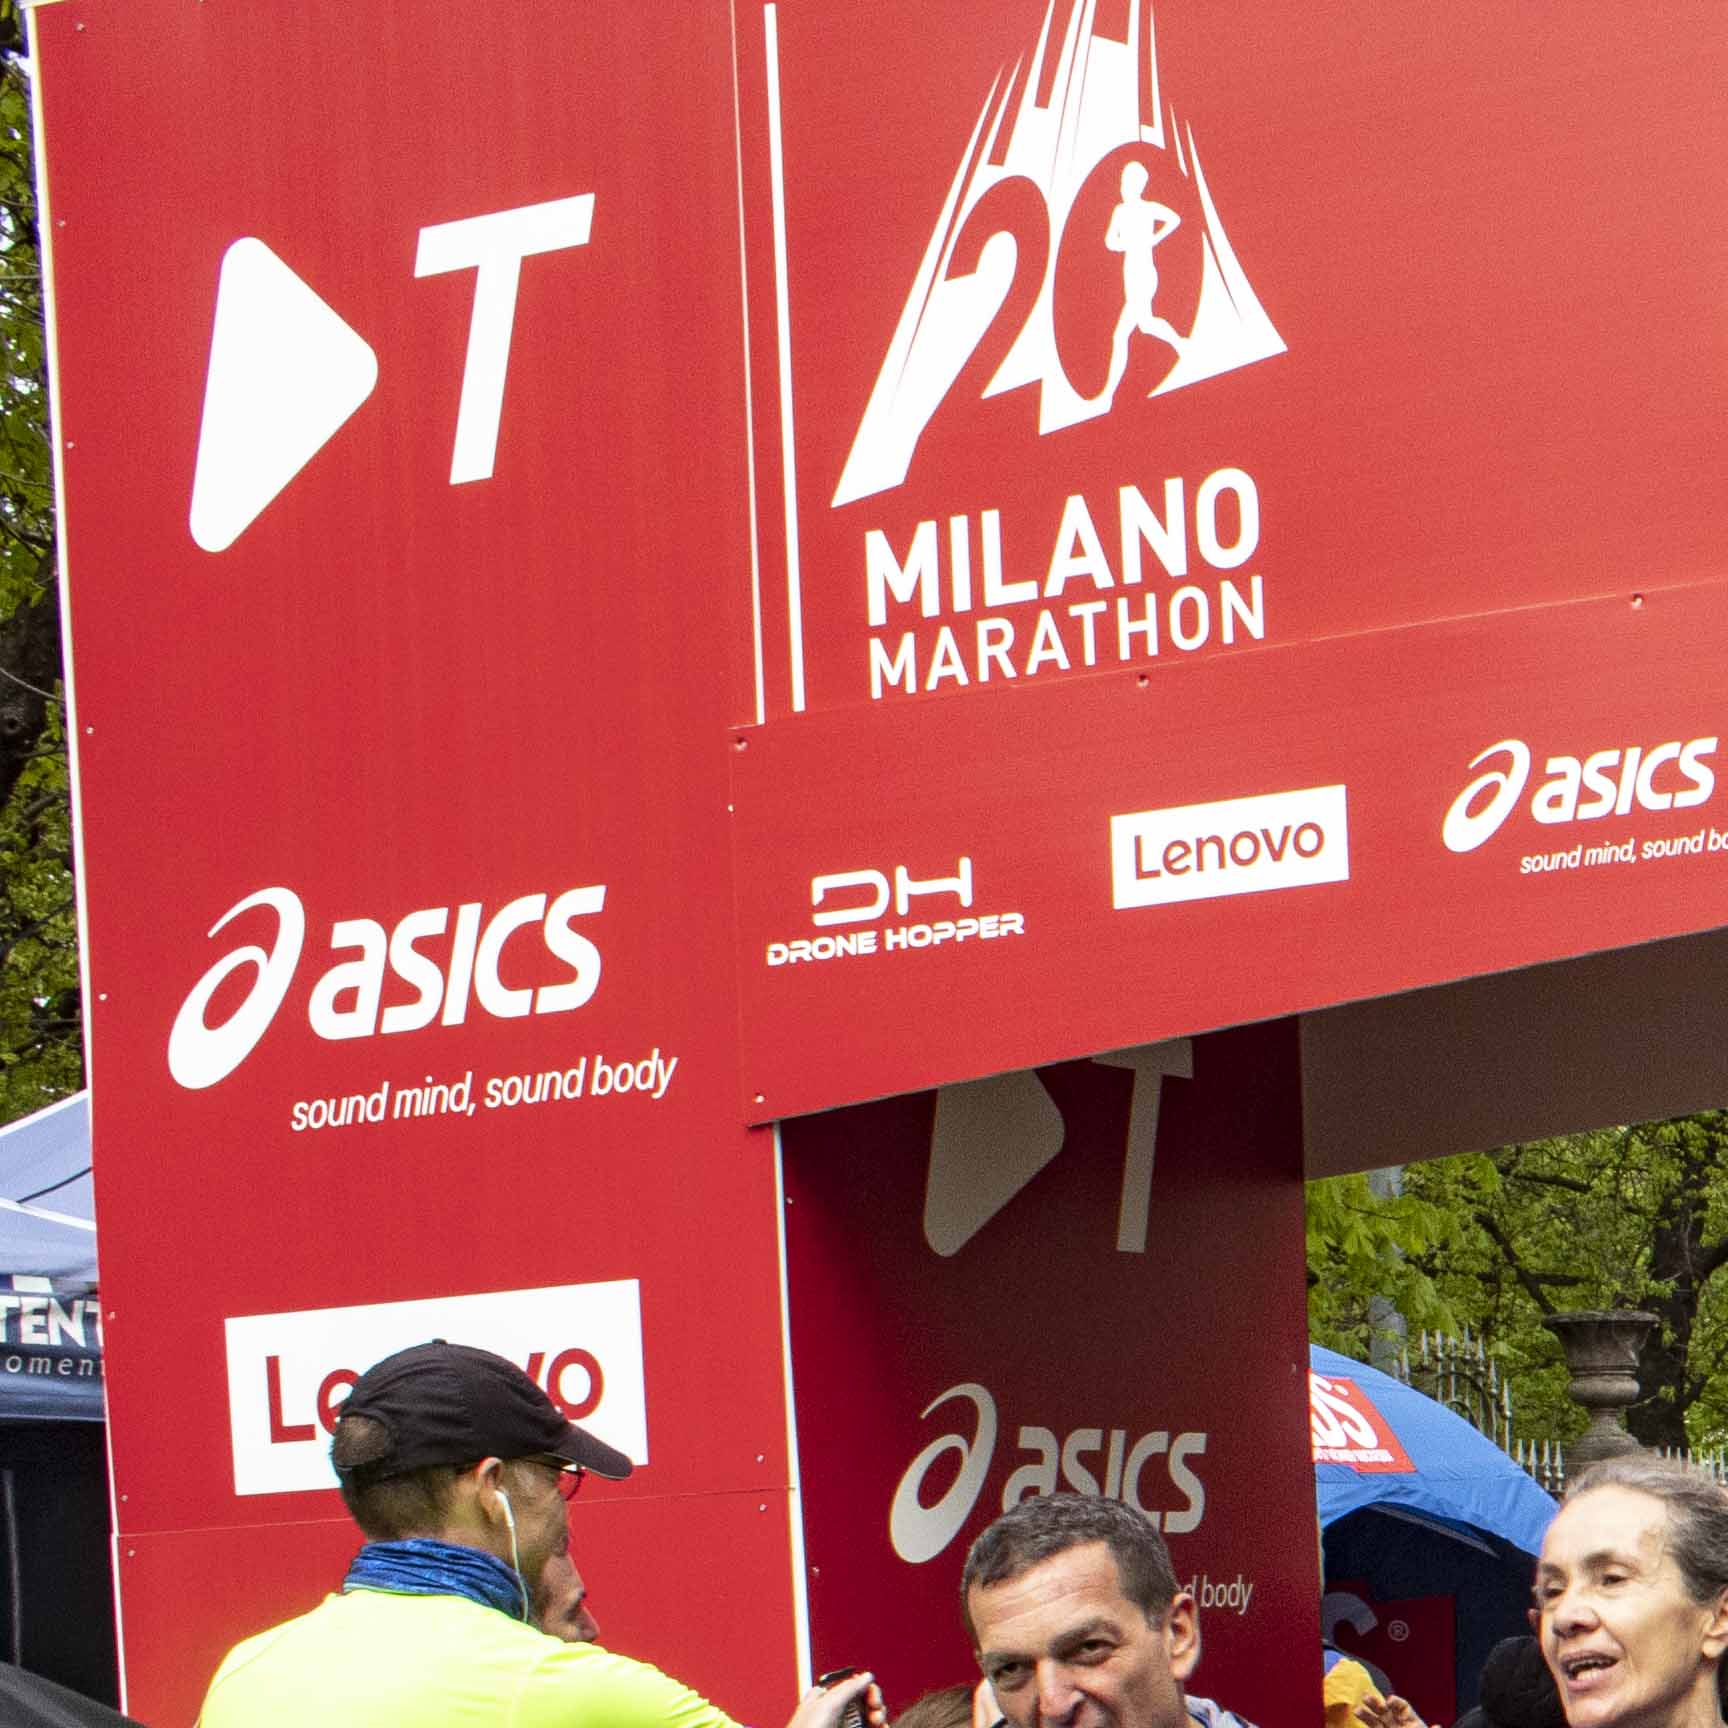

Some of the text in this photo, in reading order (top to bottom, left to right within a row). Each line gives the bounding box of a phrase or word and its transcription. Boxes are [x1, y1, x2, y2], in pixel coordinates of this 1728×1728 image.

[865, 466, 1260, 626] MILANO
[869, 575, 1265, 699] MARATHON
[1134, 820, 1326, 881] Lenovo
[1520, 848, 1582, 874] sound
[1586, 838, 1638, 867] mind,
[1642, 832, 1702, 863] sound
[810, 856, 973, 927] DH
[766, 911, 1025, 966] DRONE HOPPER
[291, 1050, 678, 1133] sound mind, sound body
[265, 1347, 604, 1444] Leo
[1202, 1575, 1254, 1617] body
